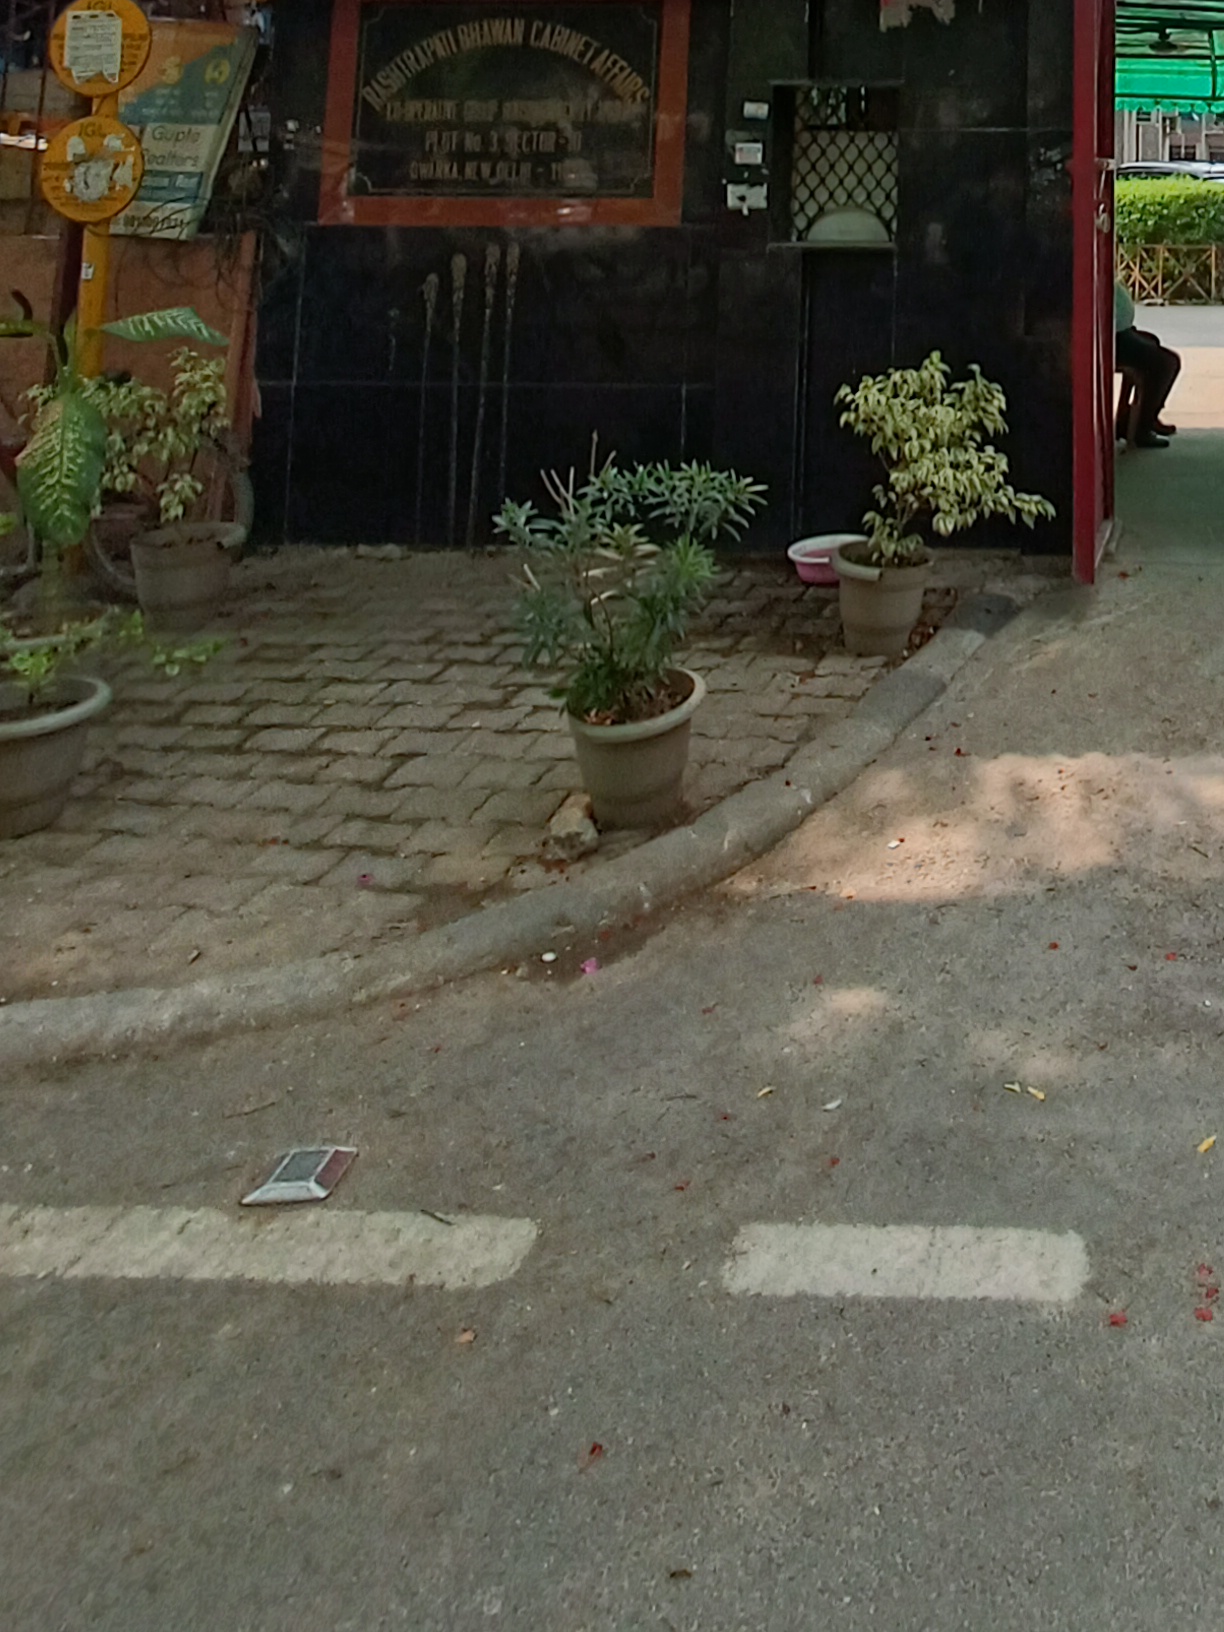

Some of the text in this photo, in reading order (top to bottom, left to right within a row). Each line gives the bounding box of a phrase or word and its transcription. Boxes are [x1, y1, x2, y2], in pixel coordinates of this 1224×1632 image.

[457, 18, 525, 50] BHAWAN
[530, 20, 602, 65] CABINET
[590, 49, 651, 105] AFFAIRS
[78, 123, 106, 138] IGL
[152, 125, 201, 148] Gupta
